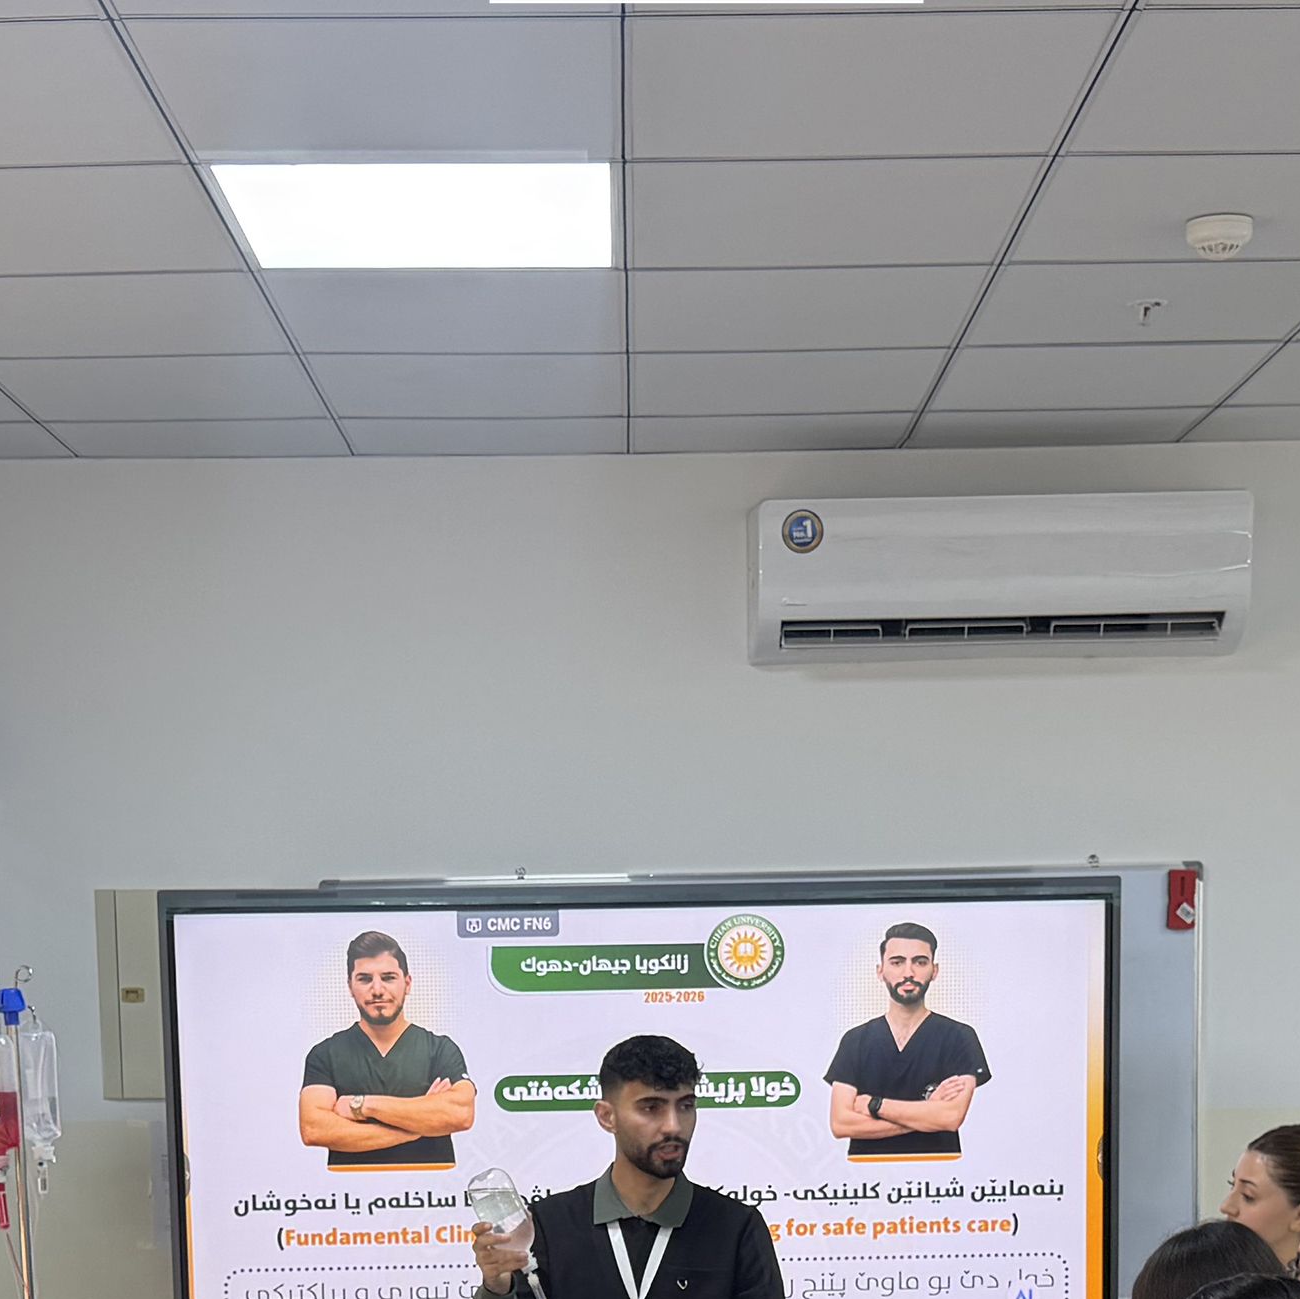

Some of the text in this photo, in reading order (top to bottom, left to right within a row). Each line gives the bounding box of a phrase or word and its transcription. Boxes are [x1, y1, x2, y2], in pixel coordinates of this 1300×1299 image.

[487, 917, 552, 932] CMC FN6
[733, 916, 782, 947] UNIVERSITY
[644, 990, 705, 1004] 2025-2026
[276, 1225, 476, 1251] (Fundamental Clin
[786, 1218, 817, 1237] for
[821, 1216, 866, 1236] safe
[872, 1215, 961, 1240] patients
[966, 1212, 1020, 1236] care)
